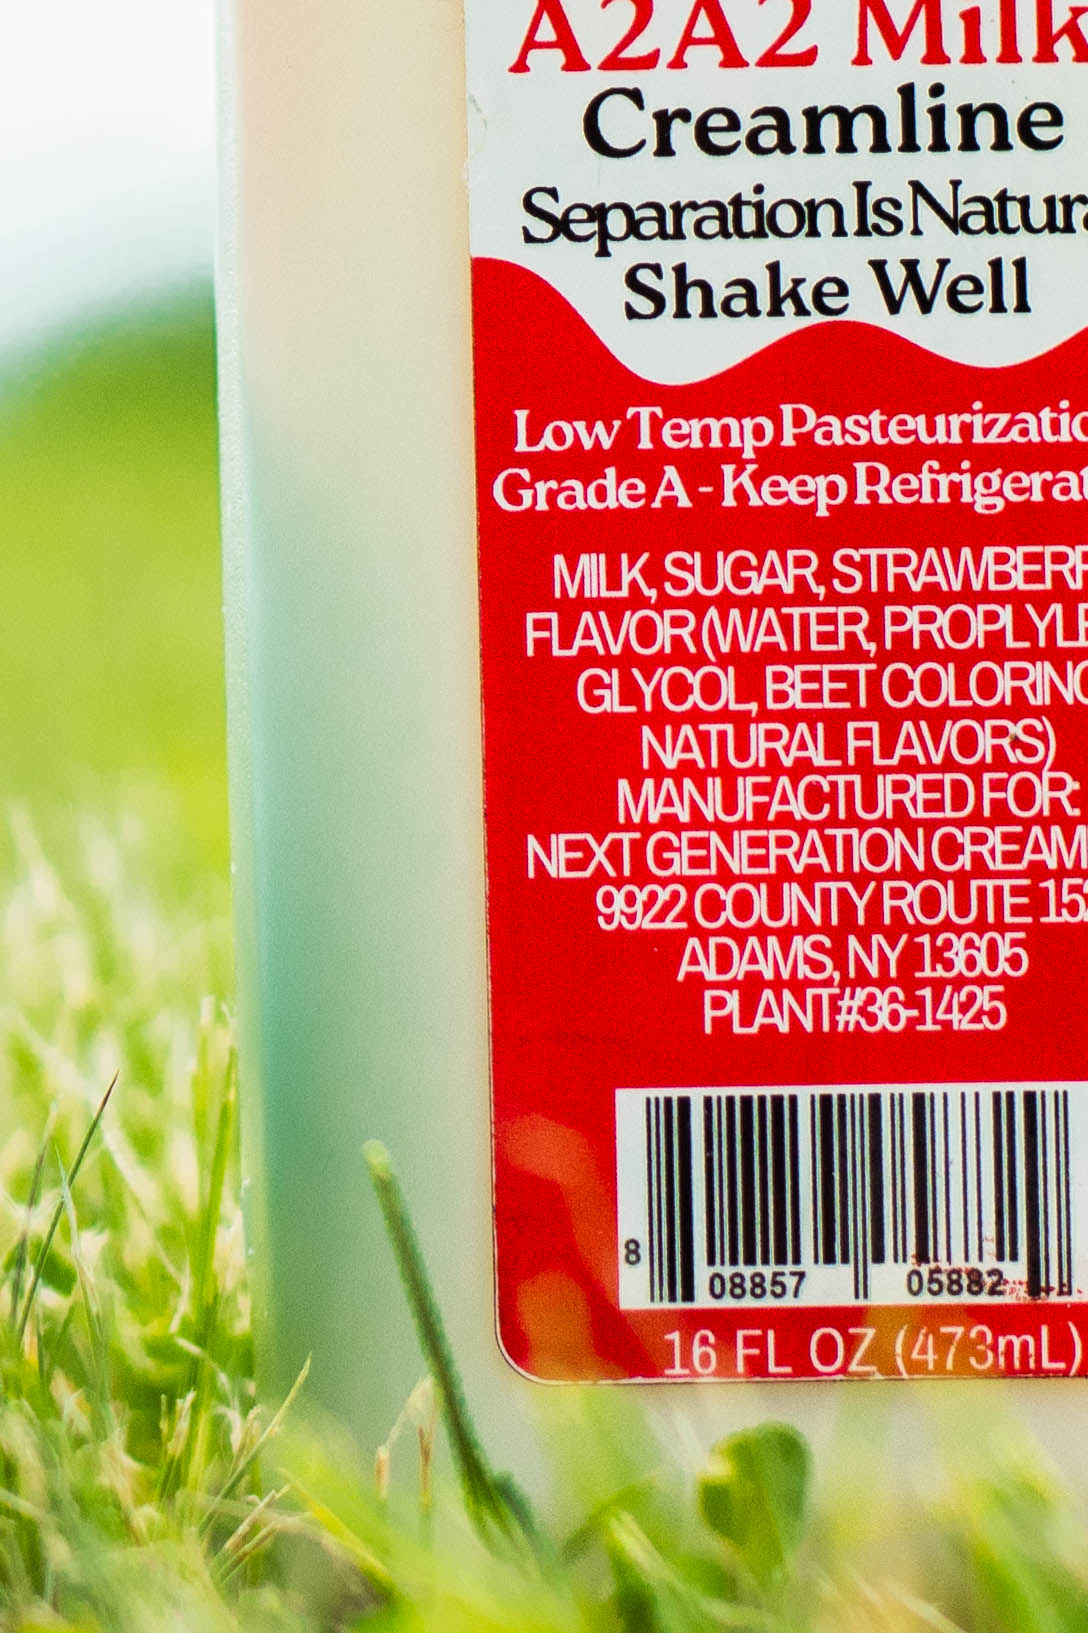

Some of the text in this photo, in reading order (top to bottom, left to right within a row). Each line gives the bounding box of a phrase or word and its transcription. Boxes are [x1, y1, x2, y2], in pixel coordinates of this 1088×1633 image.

[583, 82, 1065, 158] Creamline
[521, 183, 855, 257] Separation
[852, 181, 901, 239] Is
[623, 256, 1031, 321] Shake Well
[513, 410, 622, 453] Low
[626, 407, 774, 459] Temp
[493, 468, 646, 513] Grade
[654, 467, 692, 509] A
[698, 485, 713, 493] -
[722, 464, 847, 516] Keep
[553, 551, 657, 604] MILK,
[664, 549, 826, 601] SUGAR,
[525, 608, 698, 657] FLAVOR
[701, 606, 876, 663] (WATER,
[576, 668, 758, 718] GLYCOL,
[766, 664, 877, 711] BEET
[641, 716, 1056, 773] NATURAL FLAVORS)
[617, 773, 1081, 824] MANUFACTURED FOR:
[527, 833, 641, 878] NEXT
[646, 826, 925, 876] GENERATION
[597, 885, 688, 930] 9922
[695, 881, 877, 928] COUNTY
[883, 879, 1032, 924] ROUTE
[677, 932, 1030, 986] ADAMS, NY 13605
[623, 1238, 642, 1265] 8
[708, 1271, 806, 1300] 08857
[906, 1269, 1005, 1297] 05882
[663, 1321, 1082, 1376] 16 FL OZ (473mL)
